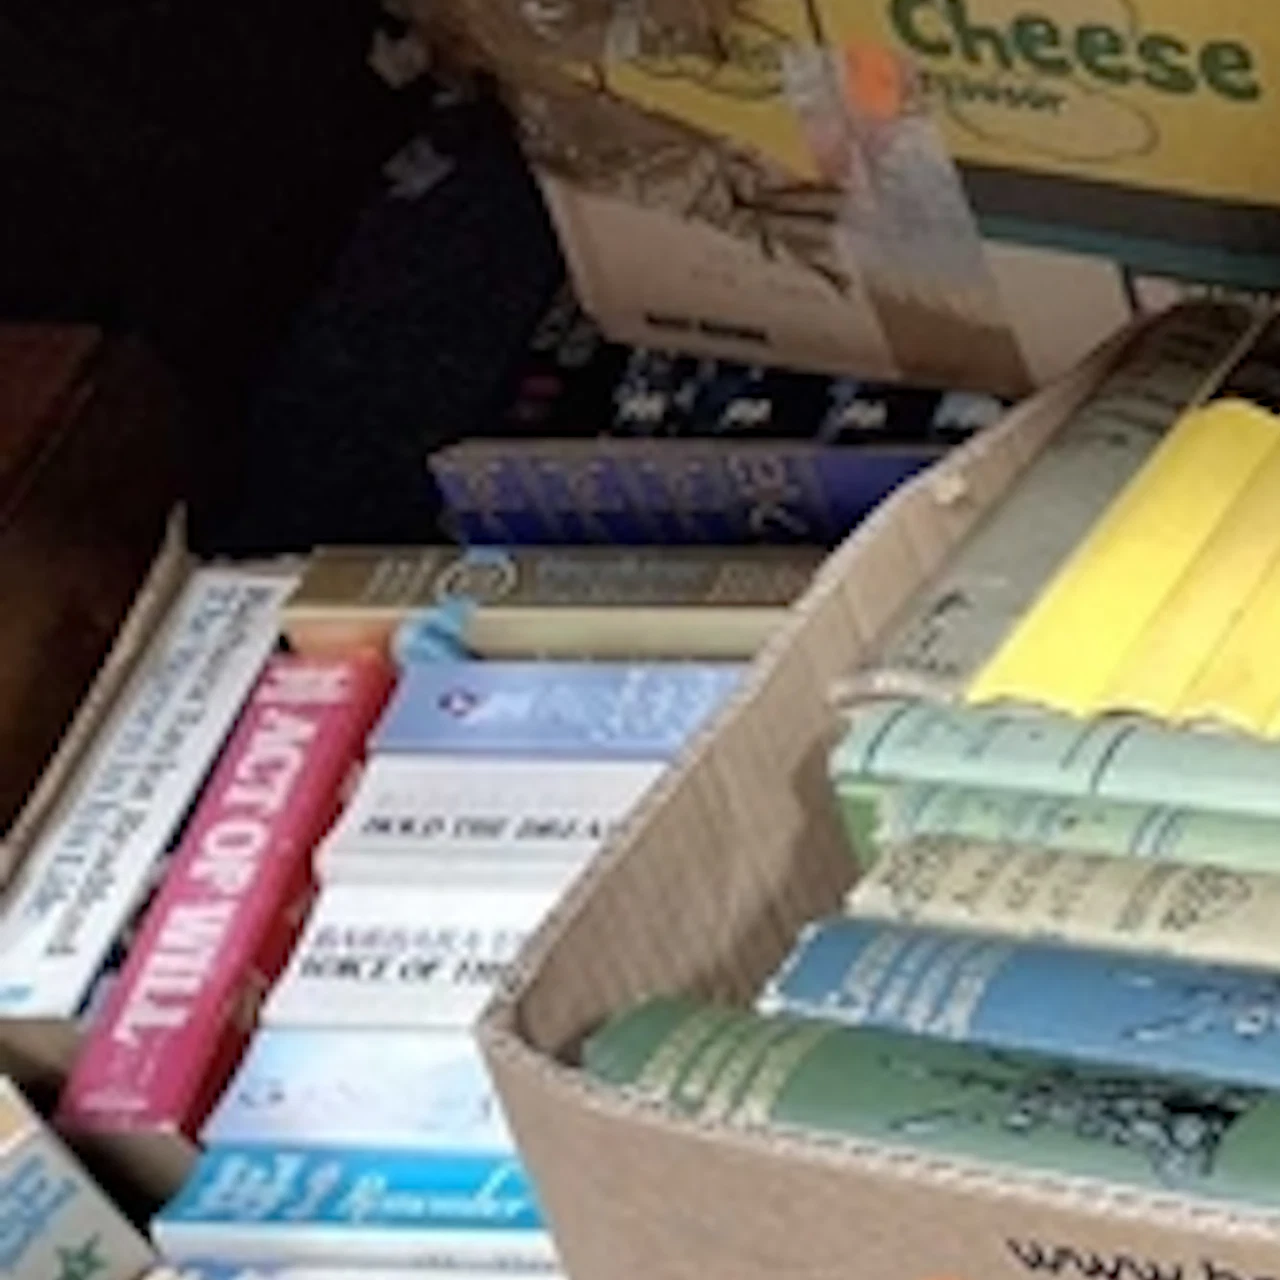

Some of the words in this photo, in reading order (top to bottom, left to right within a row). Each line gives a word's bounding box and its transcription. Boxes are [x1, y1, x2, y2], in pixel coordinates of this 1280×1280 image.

[220, 710, 321, 812] ACT
[190, 820, 272, 889] OF
[112, 900, 242, 1044] WILL
